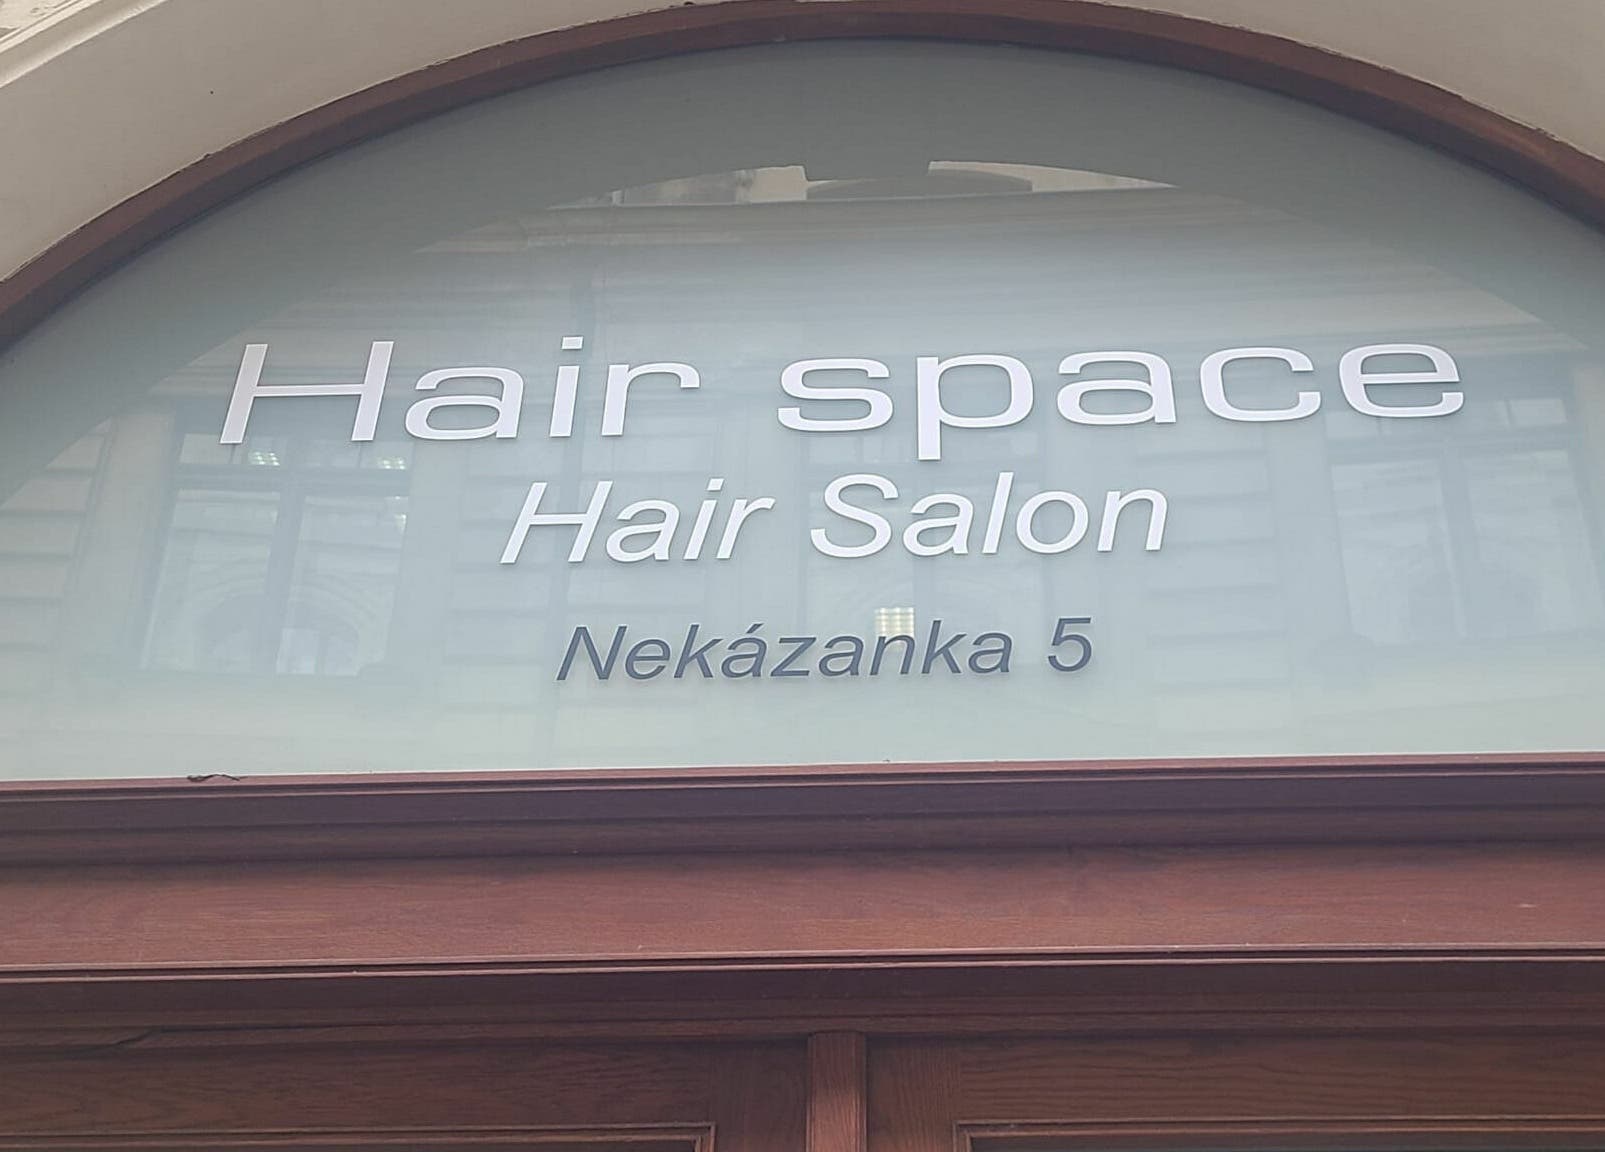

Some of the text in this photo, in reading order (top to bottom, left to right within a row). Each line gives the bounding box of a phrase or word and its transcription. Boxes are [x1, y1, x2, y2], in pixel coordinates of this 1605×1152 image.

[219, 336, 1465, 460] Hair space
[500, 472, 1169, 564] Hair Salon
[556, 617, 1093, 681] Nekázanka 5
